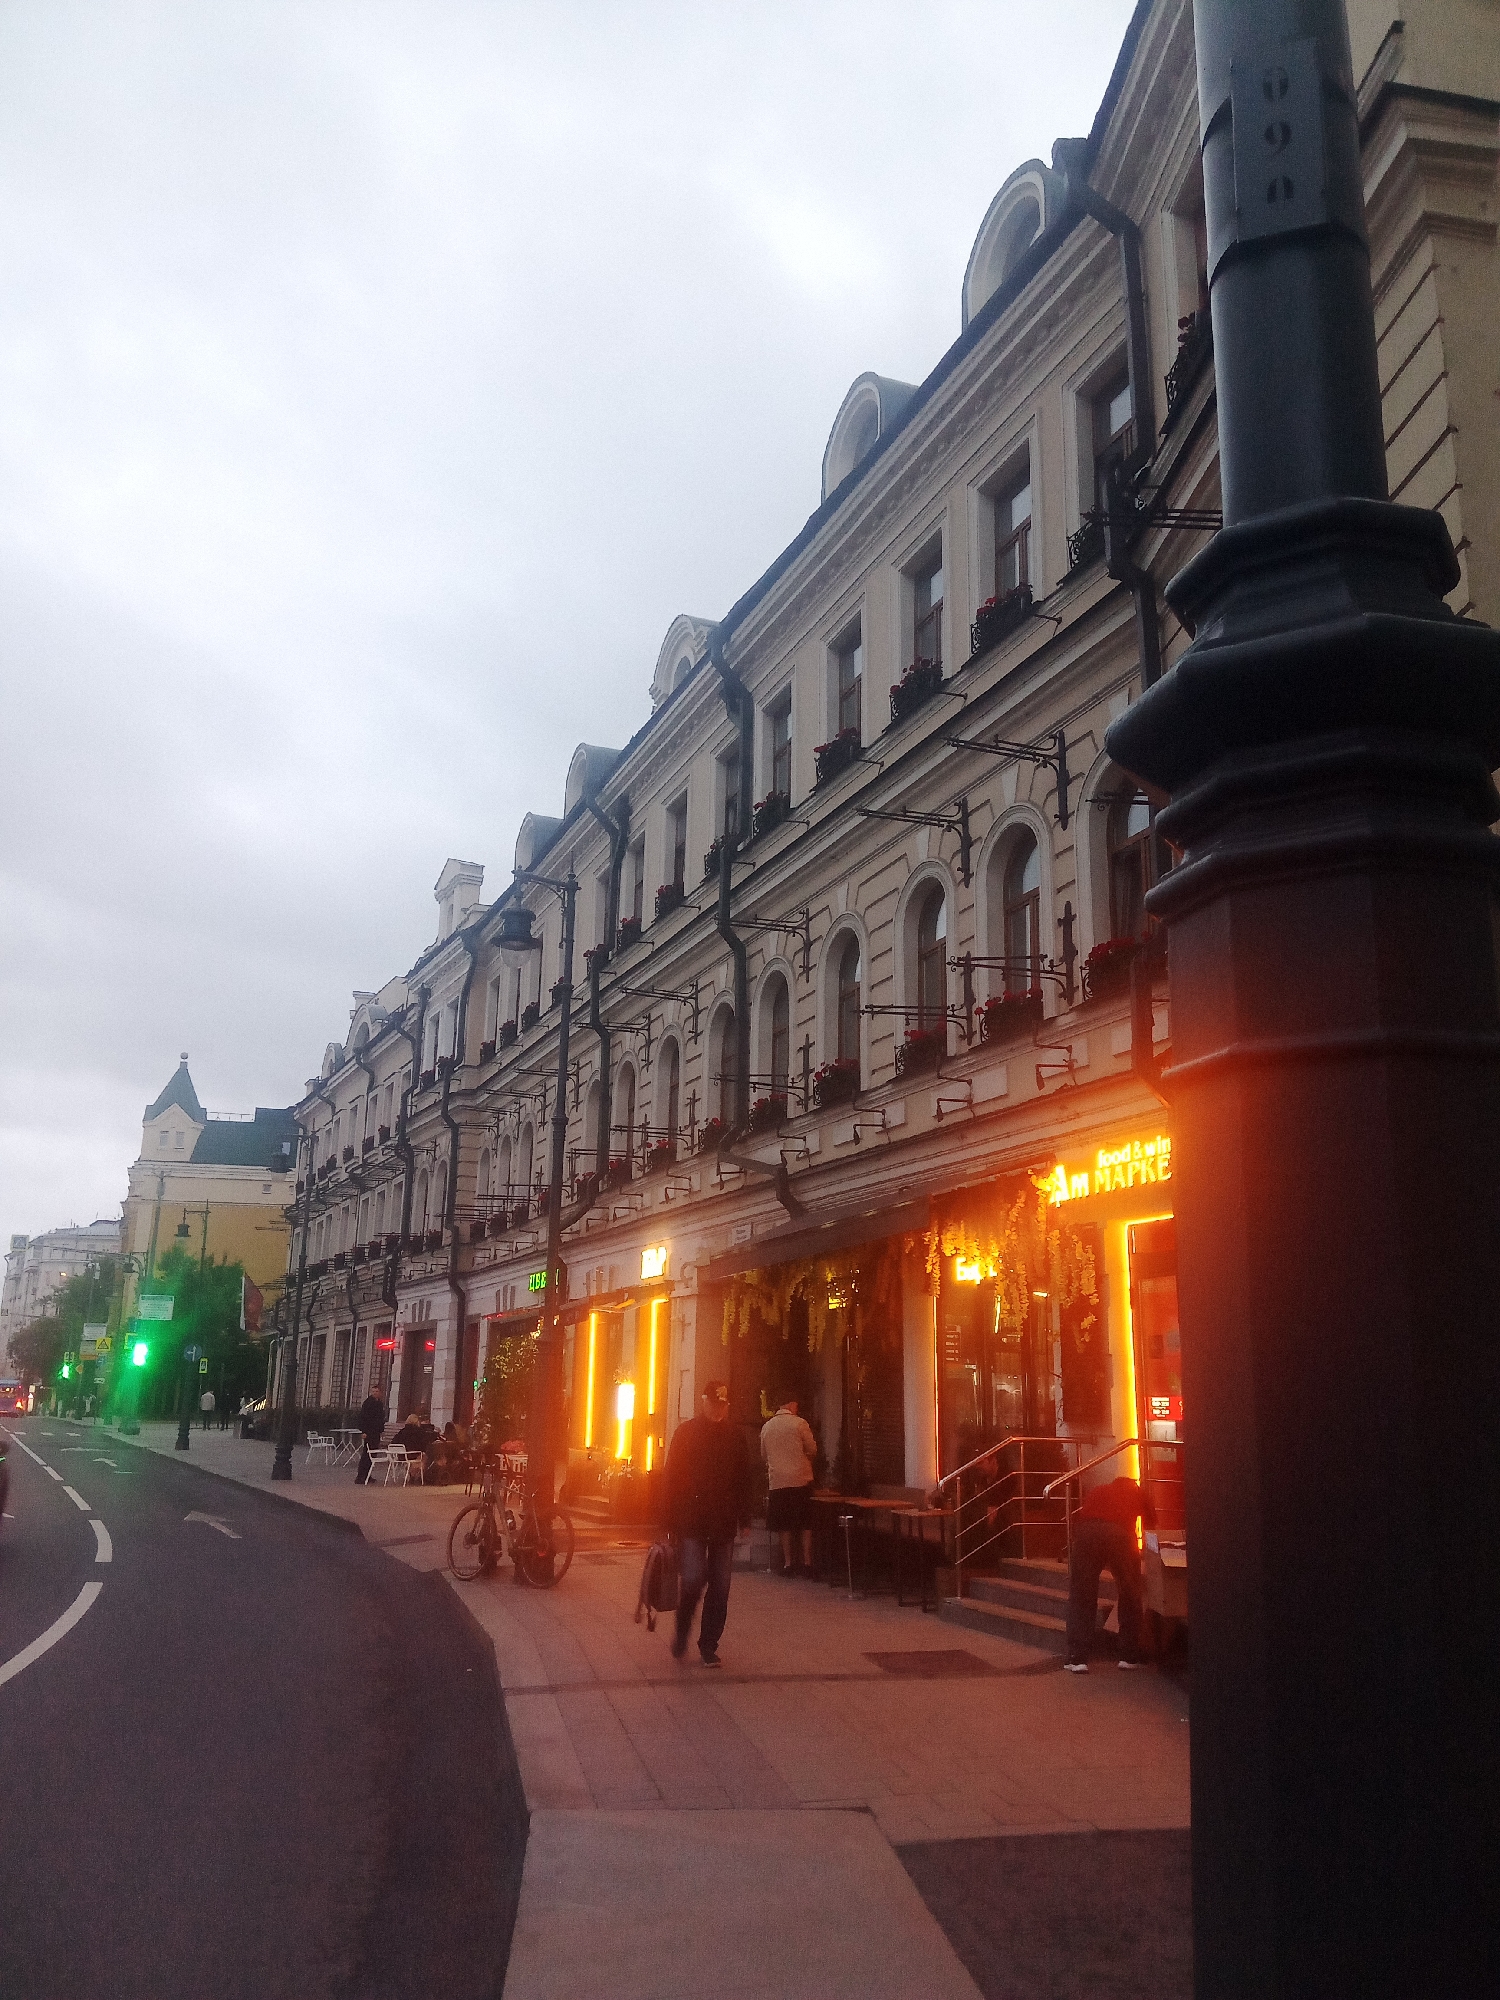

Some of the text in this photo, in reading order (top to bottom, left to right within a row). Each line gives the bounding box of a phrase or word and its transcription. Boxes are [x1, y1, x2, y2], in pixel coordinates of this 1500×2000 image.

[1097, 1135, 1172, 1168] food & win
[1094, 1153, 1173, 1194] МАРКЕ
